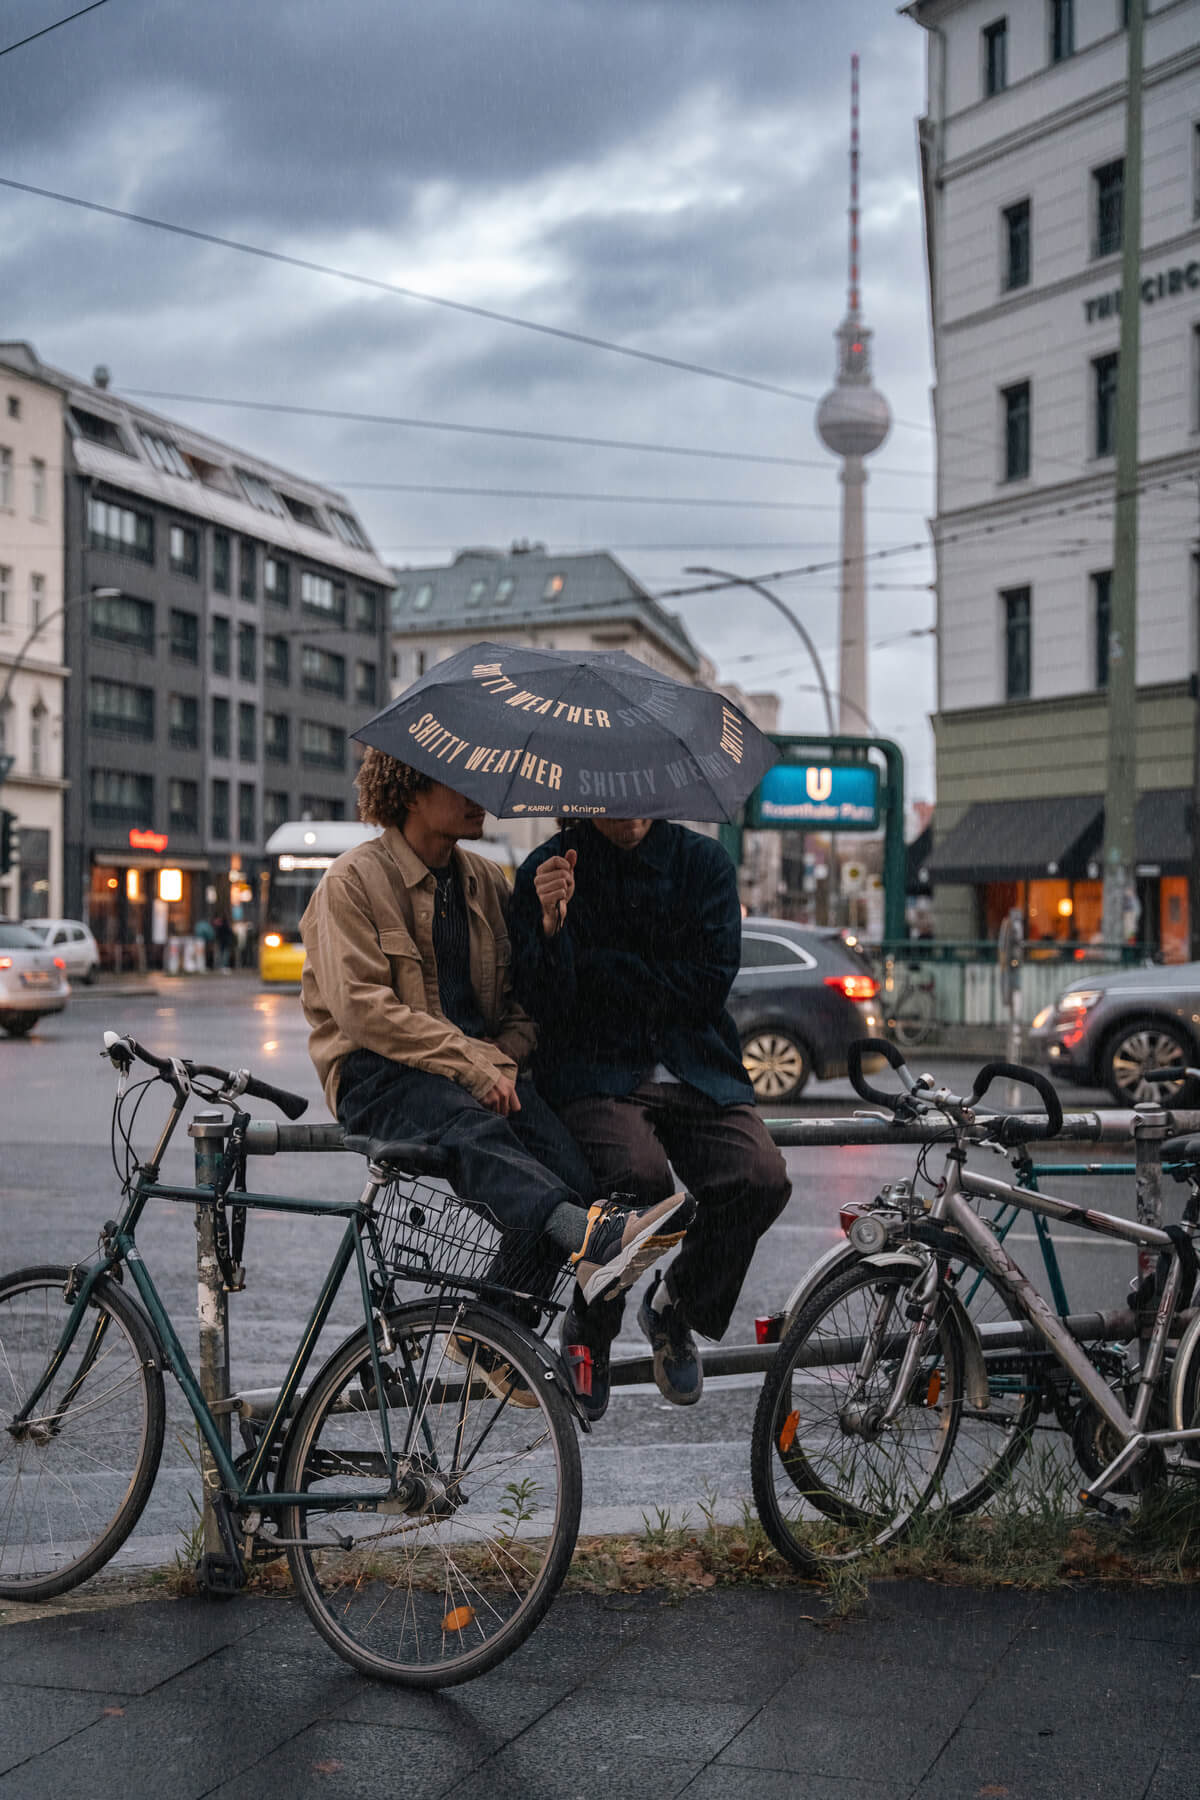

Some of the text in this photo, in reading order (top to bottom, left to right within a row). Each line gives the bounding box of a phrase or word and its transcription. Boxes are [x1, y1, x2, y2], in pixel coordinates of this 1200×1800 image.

[504, 690, 611, 728] WEATHER
[408, 712, 563, 790] SHITTY WEATHER
[720, 706, 743, 765] SHITTY
[579, 768, 658, 798] SHITTY
[806, 767, 832, 801] U
[527, 804, 554, 812] KARHU
[571, 804, 606, 815] Knirps
